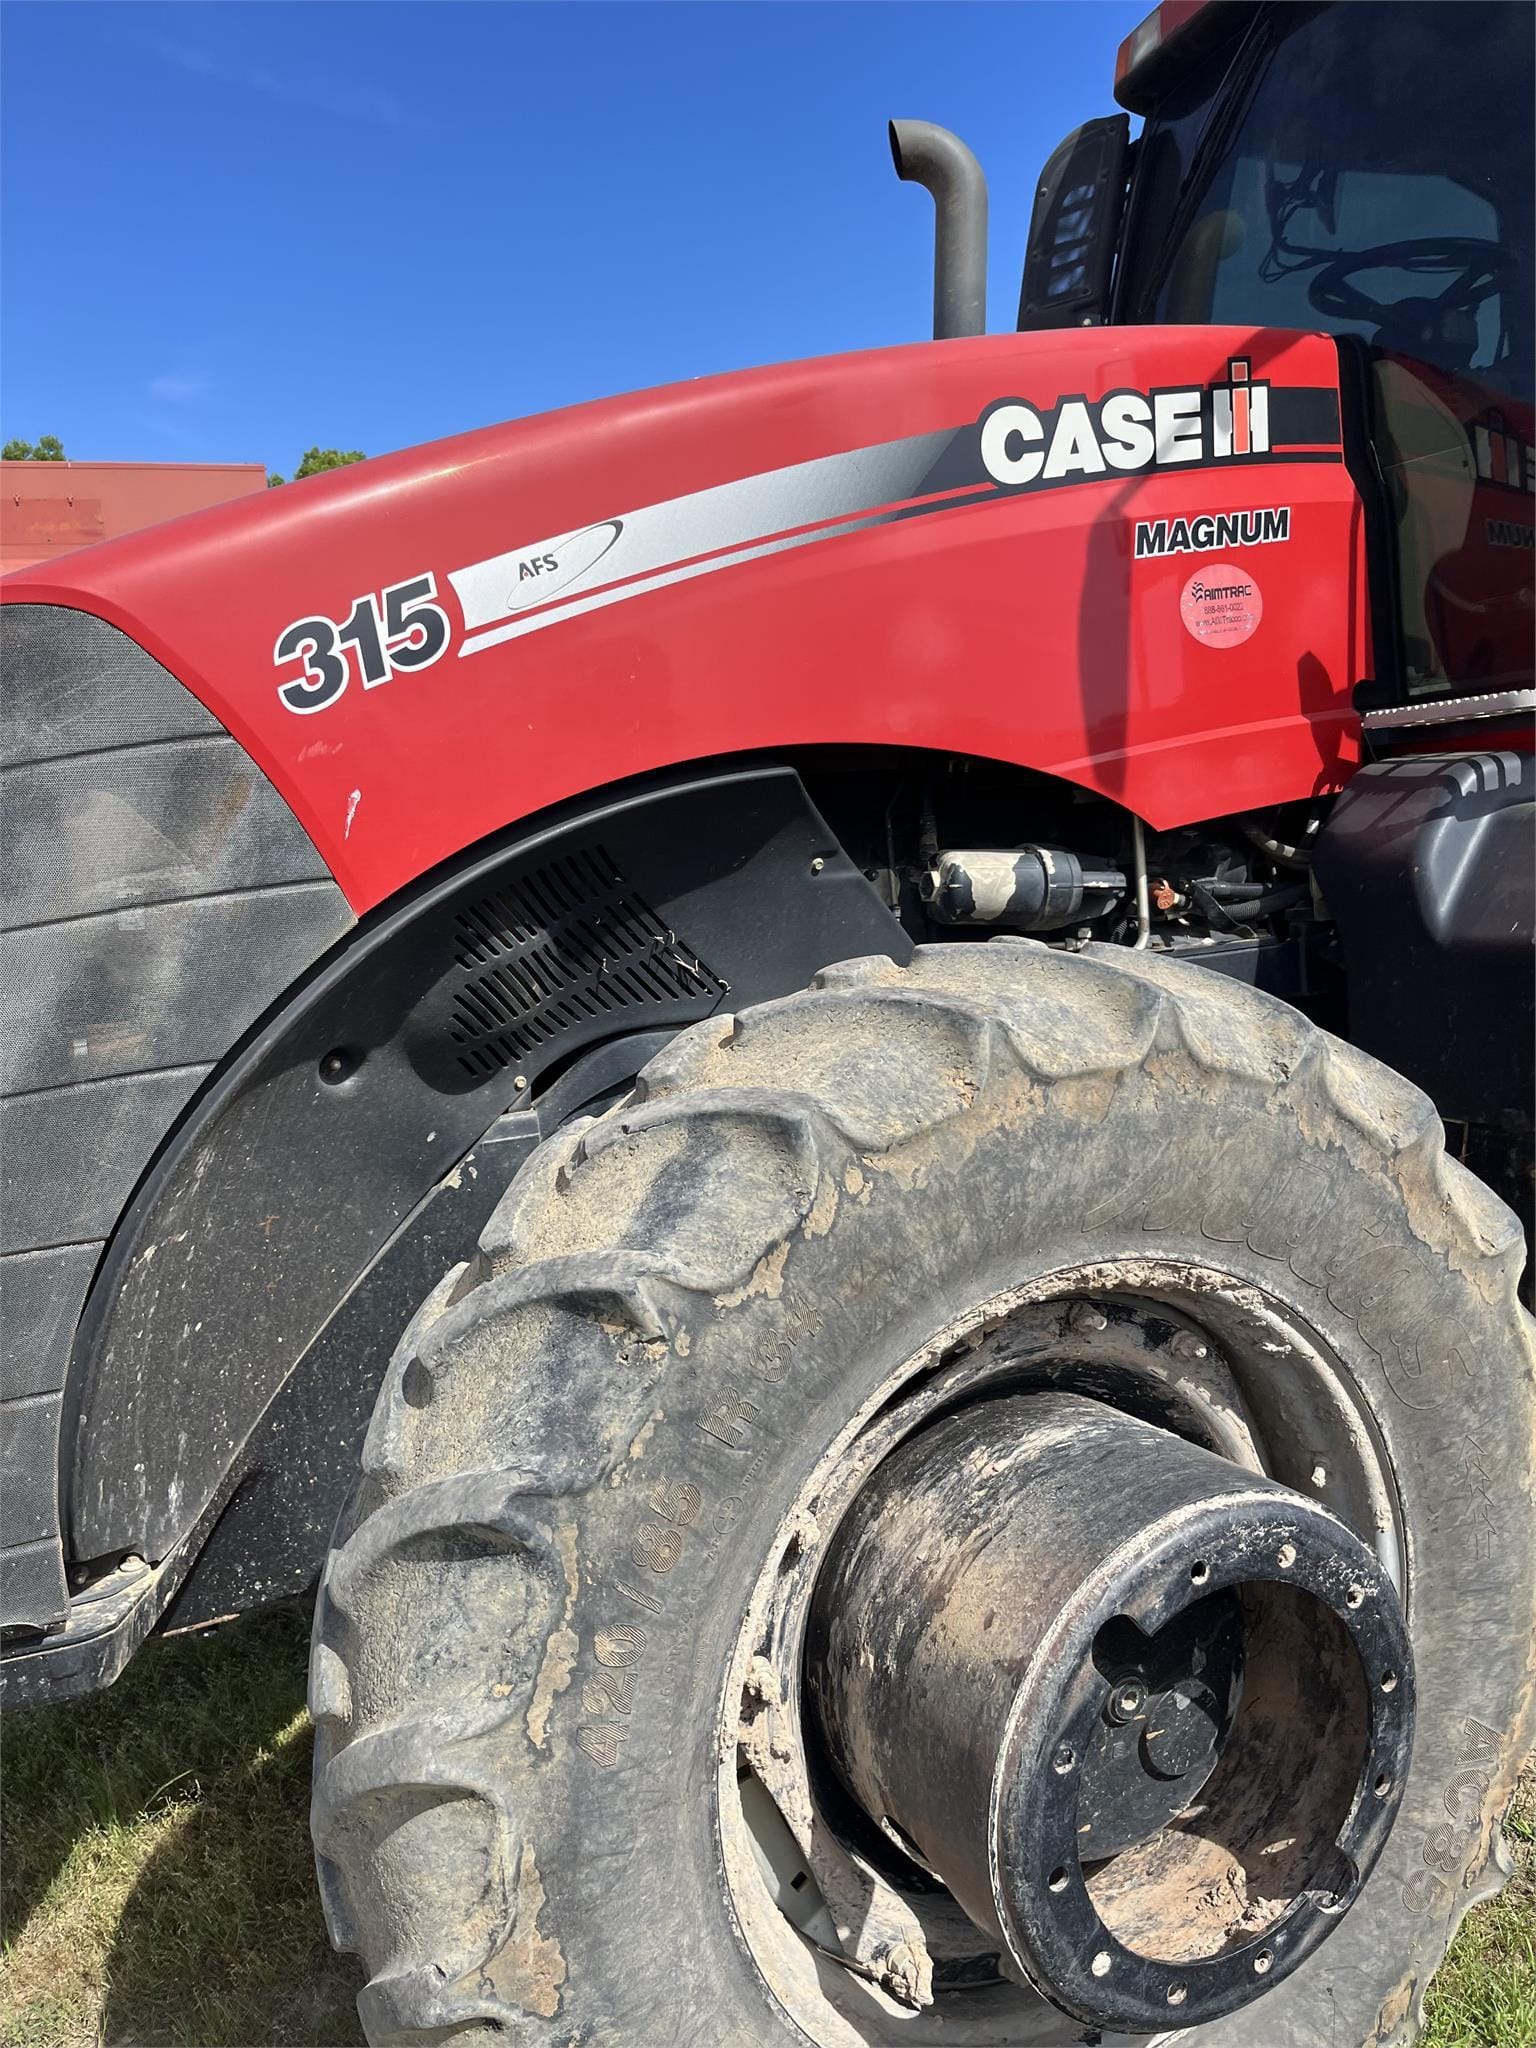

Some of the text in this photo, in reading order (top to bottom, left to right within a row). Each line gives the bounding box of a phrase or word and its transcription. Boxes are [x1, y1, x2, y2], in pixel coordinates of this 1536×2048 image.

[980, 390, 1203, 486] CASE
[1135, 507, 1290, 558] MAGNUM
[518, 553, 560, 582] AFS
[1204, 585, 1252, 601] AIMTRAC
[273, 571, 450, 715] 315
